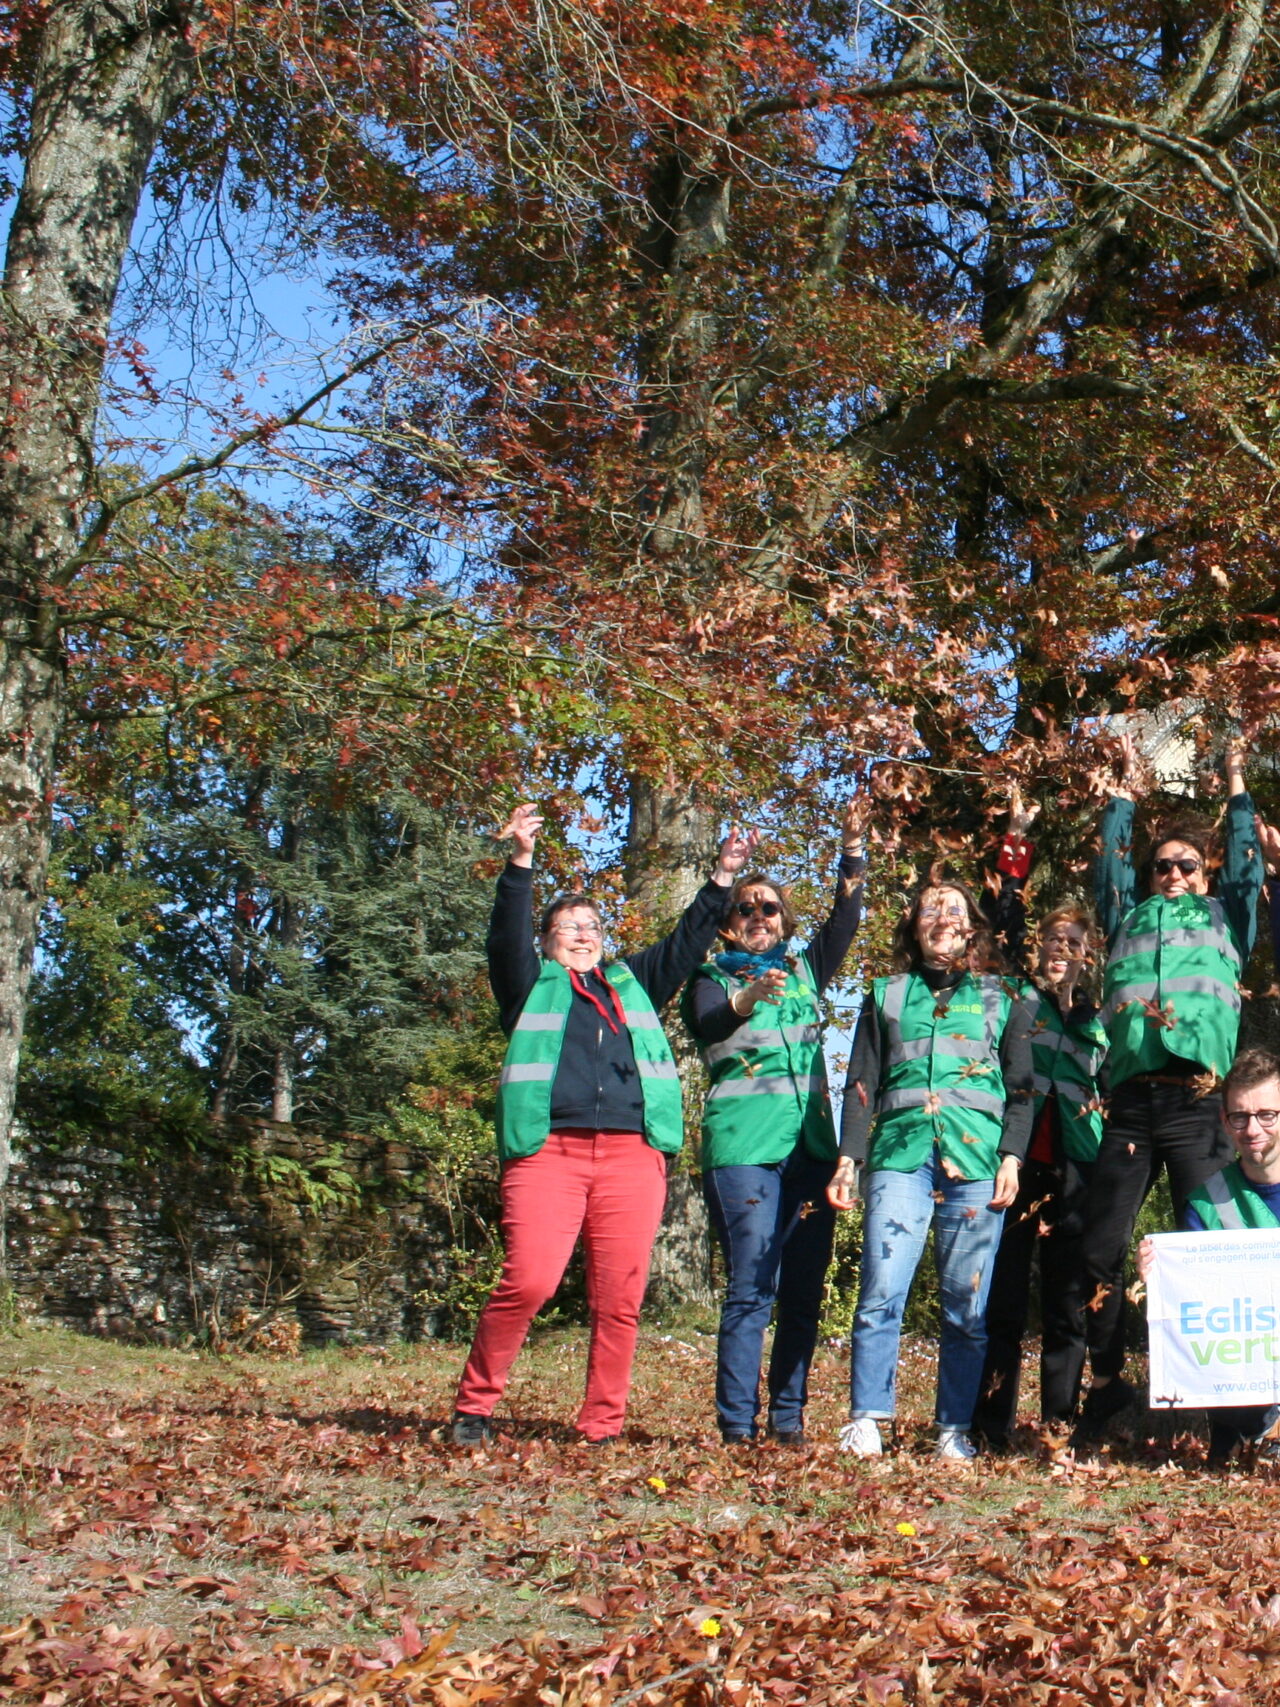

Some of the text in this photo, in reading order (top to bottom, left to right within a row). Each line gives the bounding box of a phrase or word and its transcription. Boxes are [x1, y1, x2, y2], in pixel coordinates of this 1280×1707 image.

[1186, 1245, 1198, 1253] Le
[1199, 1243, 1222, 1252] label
[1224, 1243, 1240, 1251] des
[1182, 1255, 1196, 1265] qui
[1249, 1252, 1270, 1262] pour
[1272, 1250, 1280, 1259] le
